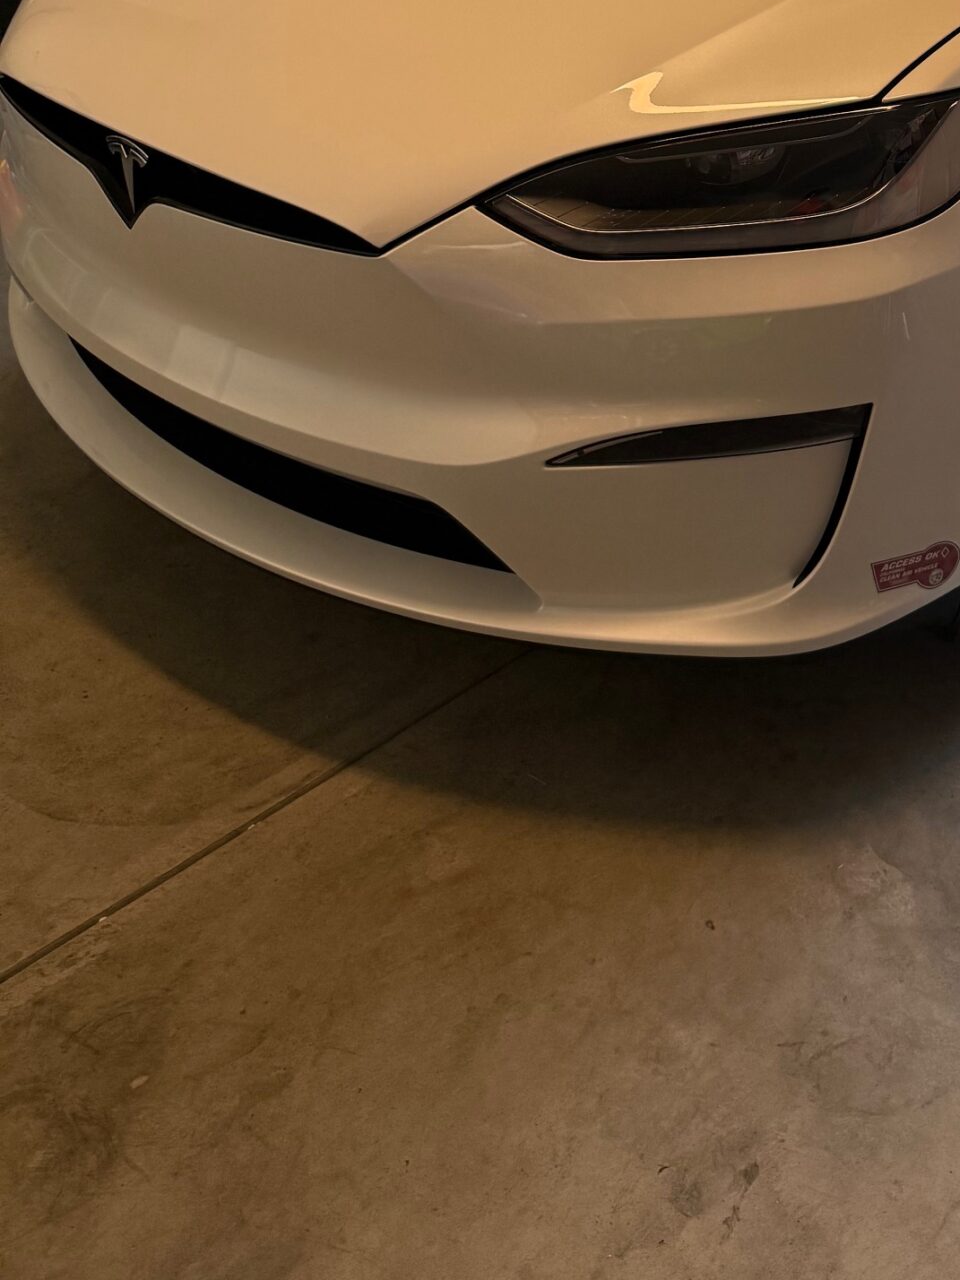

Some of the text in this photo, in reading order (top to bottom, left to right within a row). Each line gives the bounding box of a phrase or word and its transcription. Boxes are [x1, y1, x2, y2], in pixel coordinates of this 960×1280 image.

[881, 555, 922, 572] ACCESS
[925, 550, 941, 560] OK
[880, 572, 901, 583] CLEAN
